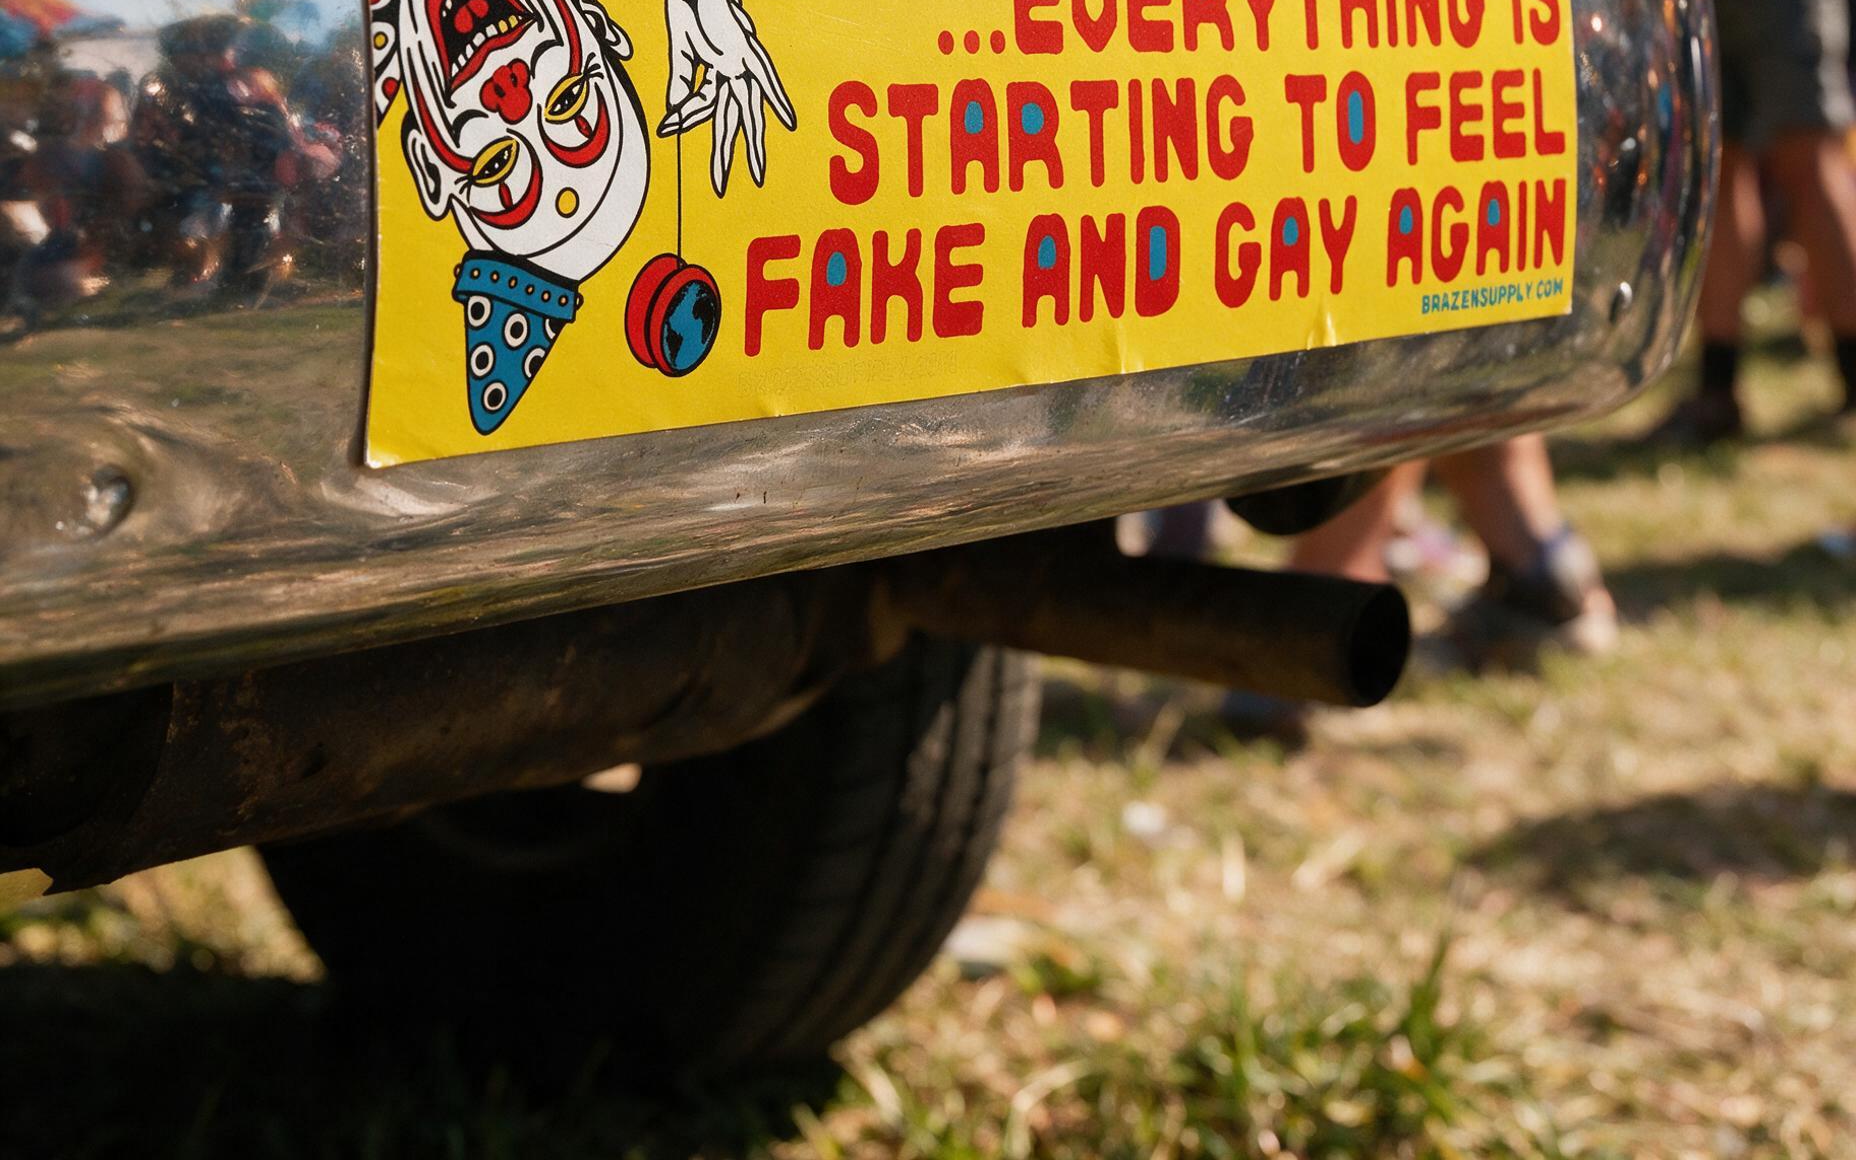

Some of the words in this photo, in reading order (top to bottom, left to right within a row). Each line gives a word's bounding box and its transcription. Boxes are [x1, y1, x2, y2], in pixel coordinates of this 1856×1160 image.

[829, 75, 1253, 205] STARTING
[1285, 71, 1375, 172] TO
[1405, 69, 1565, 165] FEEL
[744, 223, 985, 357] FAKE
[1022, 206, 1180, 327] AND
[1214, 196, 1357, 308] GAY
[1387, 179, 1565, 287] AGAIN
[1421, 278, 1564, 315] BRAZENSUPPLYCOM
